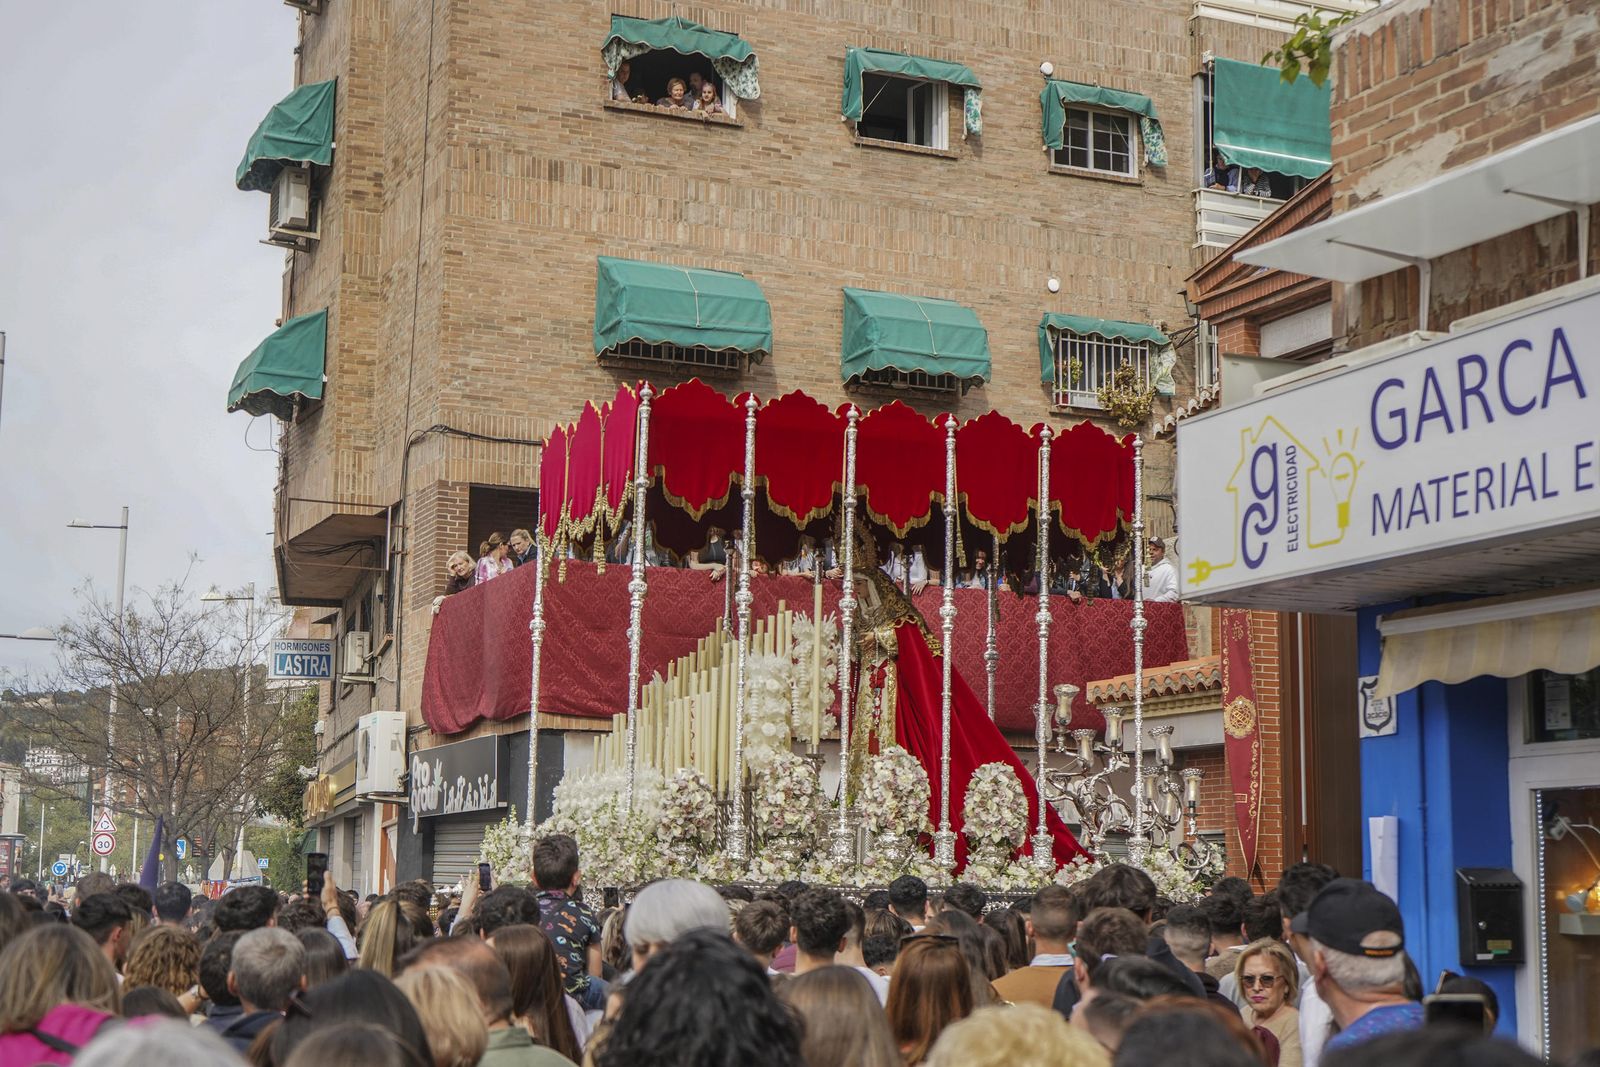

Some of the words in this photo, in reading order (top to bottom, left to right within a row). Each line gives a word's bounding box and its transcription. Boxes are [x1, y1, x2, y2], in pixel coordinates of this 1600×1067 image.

[1371, 328, 1587, 450] GARCA
[1286, 445, 1299, 553] ELECTRICIDAD
[1371, 452, 1560, 536] MATERIAL
[275, 642, 330, 652] HORMIGONES
[276, 654, 329, 676] LASTRA
[97, 841, 111, 849] 30
